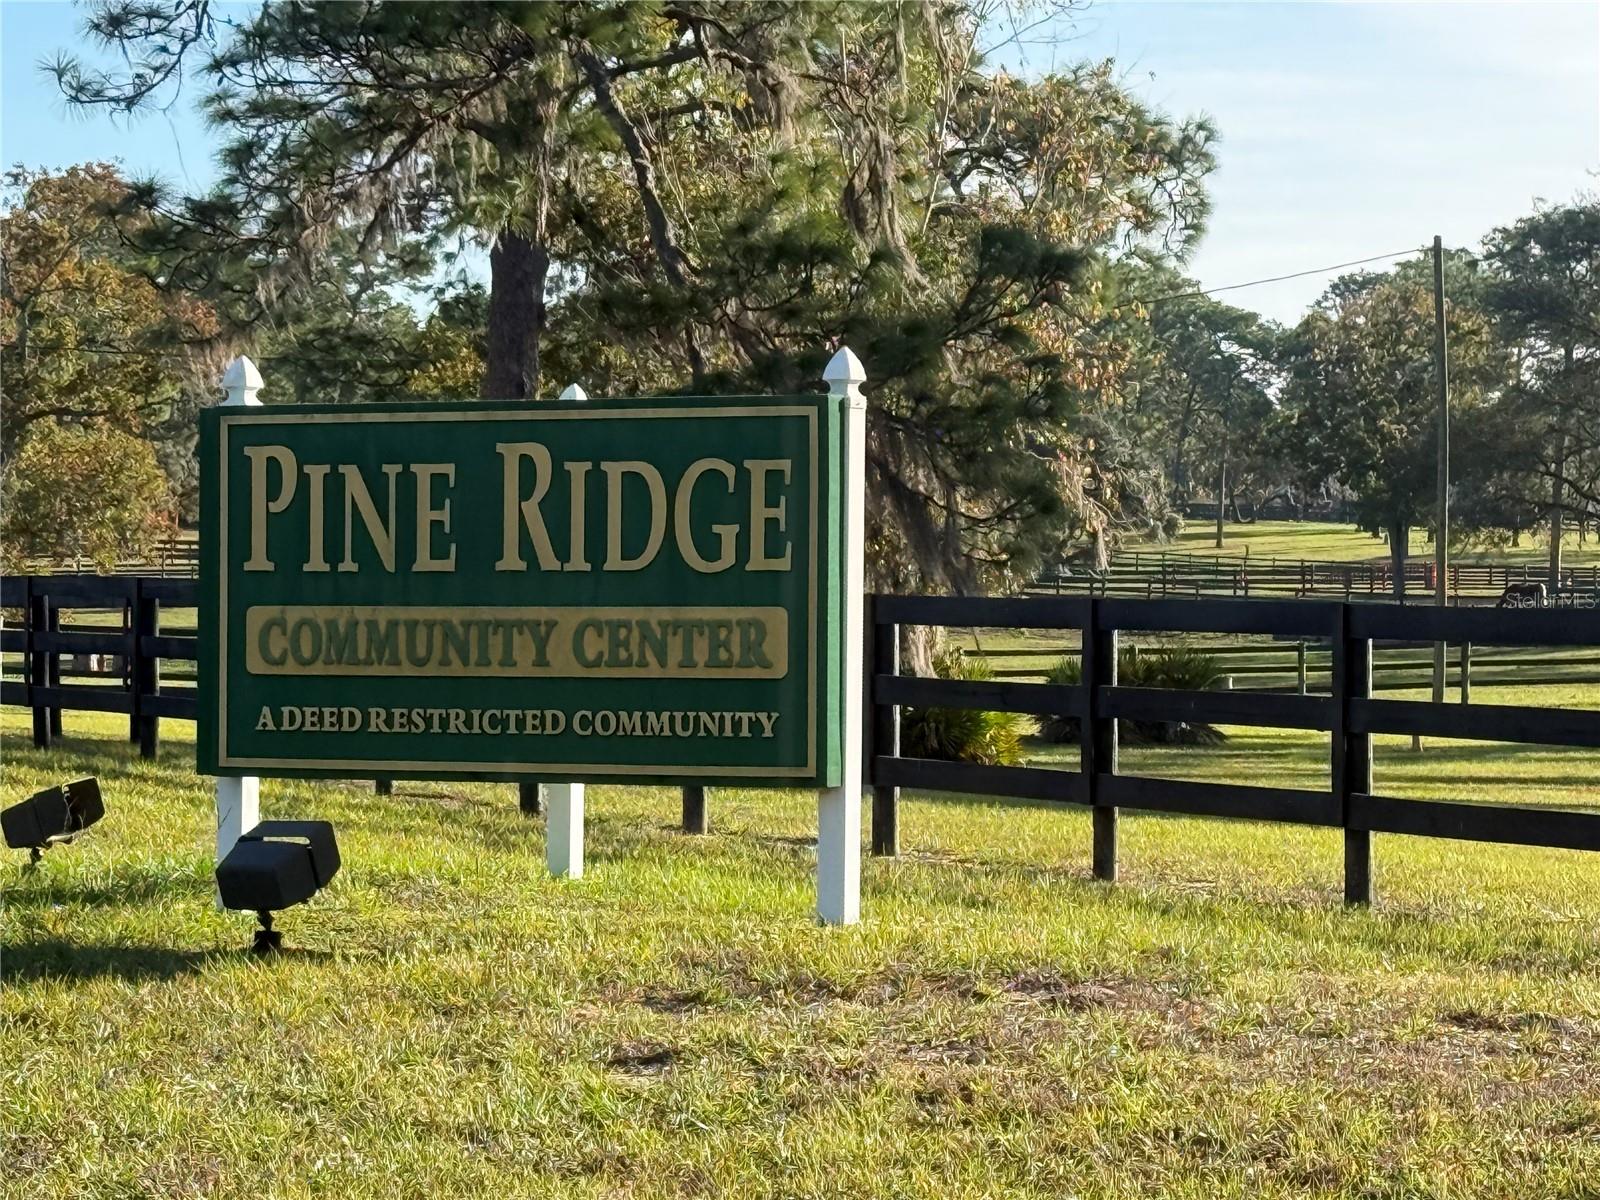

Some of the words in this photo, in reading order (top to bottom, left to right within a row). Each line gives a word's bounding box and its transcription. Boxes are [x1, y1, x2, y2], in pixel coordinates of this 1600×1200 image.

[243, 444, 456, 572] PINE
[495, 441, 792, 574] RIDGE
[258, 615, 558, 668] COMMUNITY
[572, 616, 774, 670] CENTER
[255, 705, 280, 730] A
[281, 706, 362, 733] DEED
[367, 707, 567, 735] RESTRICTED
[572, 709, 780, 738] COMMUNITY
